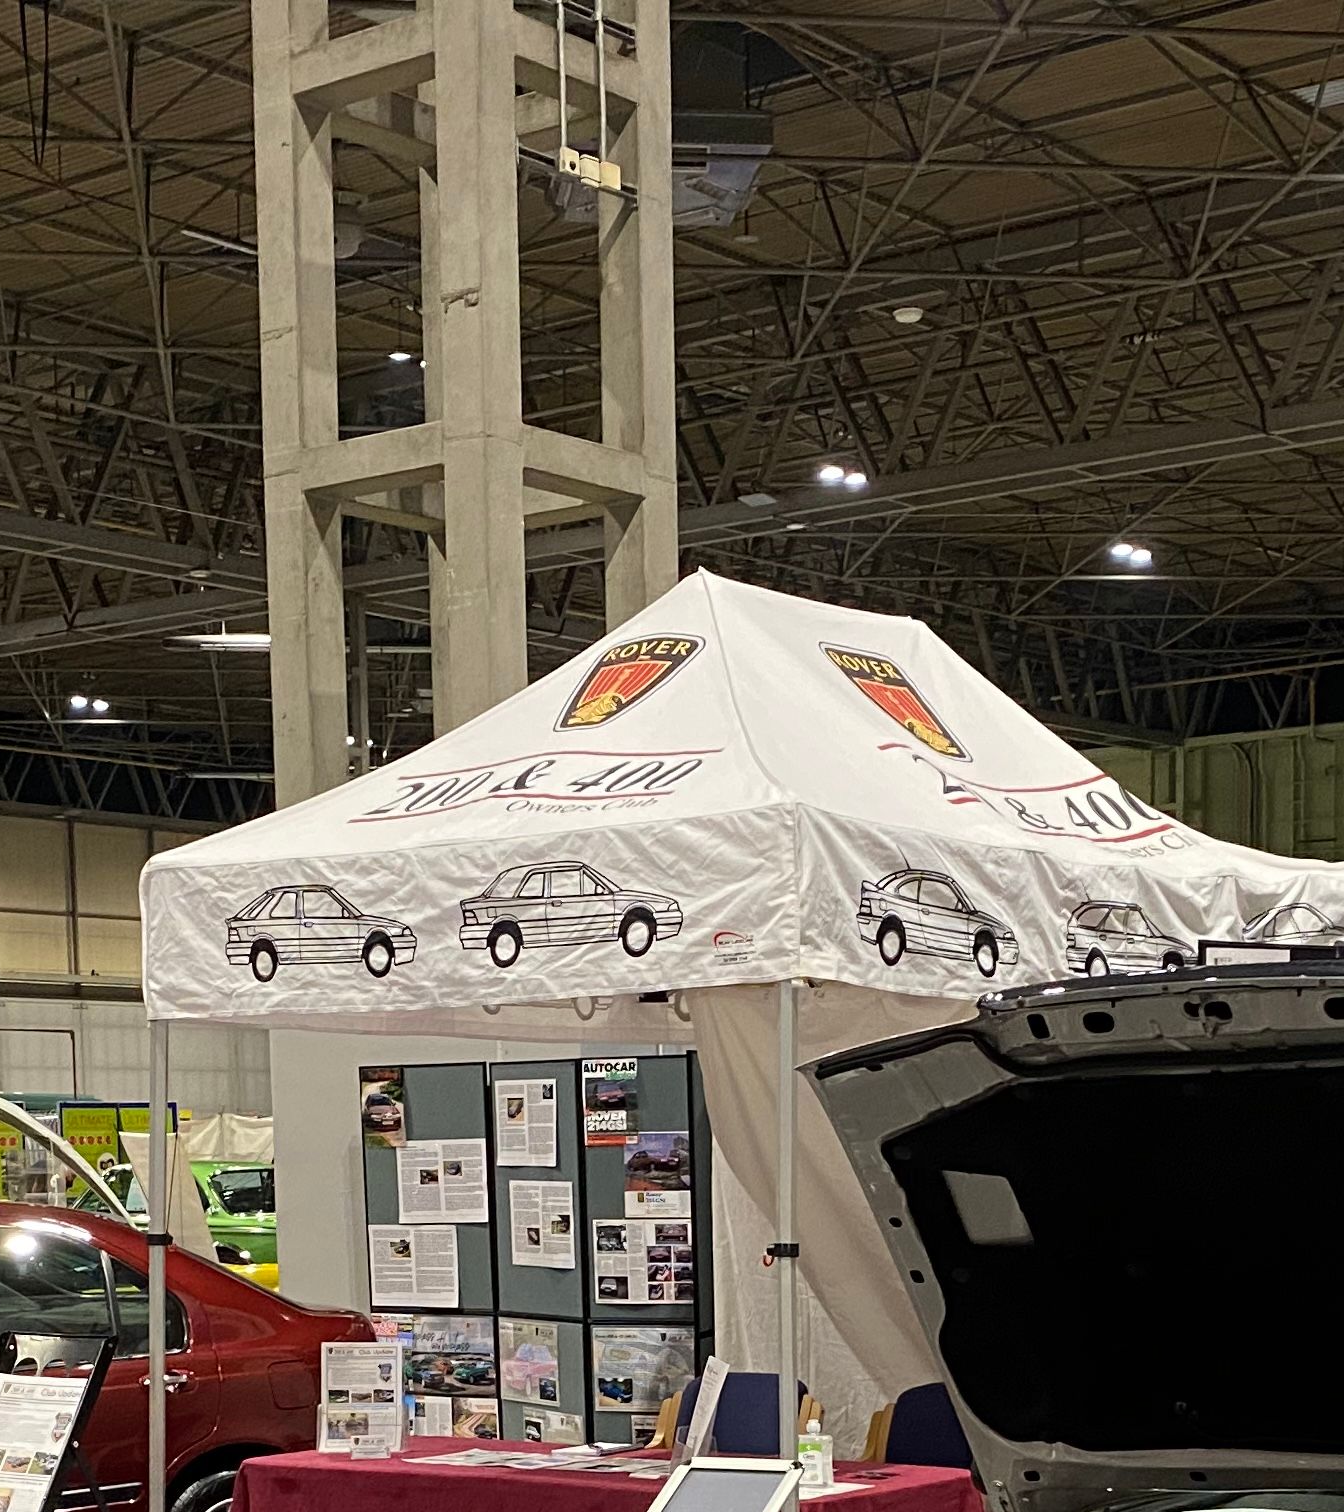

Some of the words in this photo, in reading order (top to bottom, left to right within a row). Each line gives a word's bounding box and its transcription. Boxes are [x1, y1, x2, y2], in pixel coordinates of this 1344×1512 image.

[603, 640, 691, 662] ROVER
[829, 651, 904, 680] ROVER
[362, 771, 495, 815] 200
[489, 759, 556, 793] &
[568, 758, 704, 793] 400
[505, 800, 599, 815] Owners
[601, 796, 660, 812] Club
[583, 1062, 636, 1072] AUTOCAR
[587, 1111, 626, 1121] ROVER
